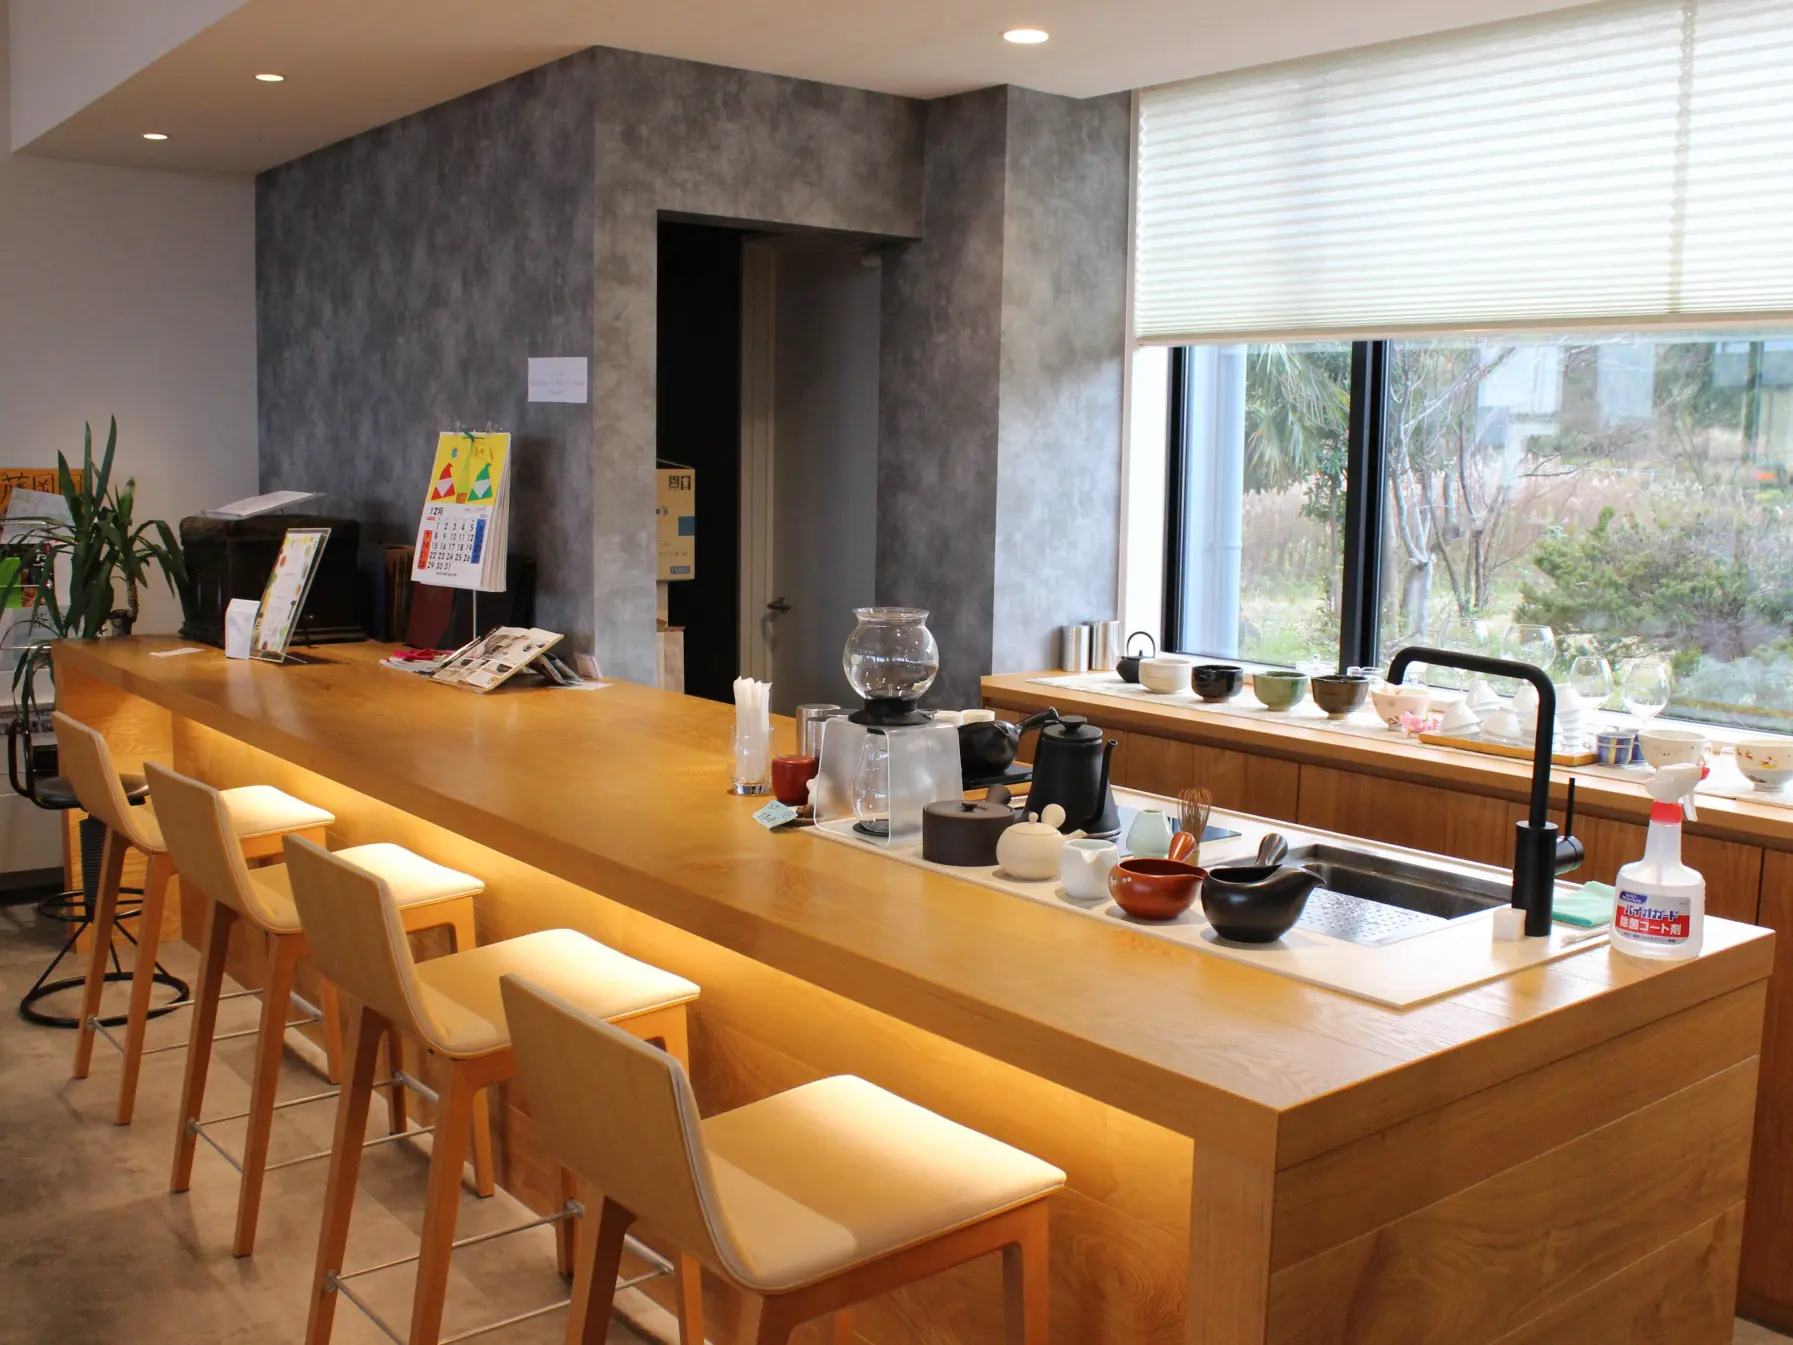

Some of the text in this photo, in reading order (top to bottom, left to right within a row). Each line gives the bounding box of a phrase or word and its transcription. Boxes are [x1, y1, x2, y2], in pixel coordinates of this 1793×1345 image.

[430, 506, 444, 516] 12月
[436, 522, 440, 530] 1
[444, 522, 449, 531] 2
[452, 523, 457, 531] 3
[461, 523, 466, 531] 4
[470, 524, 474, 532] 5
[434, 532, 439, 540] 8
[450, 533, 457, 541] 10
[458, 533, 465, 542] 11
[467, 534, 474, 542] 12
[432, 542, 439, 550] 15
[440, 542, 447, 550] 16
[448, 543, 456, 551] 17
[457, 543, 464, 551] 18
[466, 544, 473, 552] 19
[429, 551, 436, 560] 22
[437, 552, 445, 560] 23
[446, 552, 453, 561] 24
[454, 553, 462, 561] 25
[463, 554, 470, 562] 26
[427, 561, 435, 569] 29
[436, 562, 443, 570] 30
[444, 562, 452, 571] 31
[1625, 904, 1680, 921] バイオガード
[1619, 915, 1682, 935] 除菌コート剤
